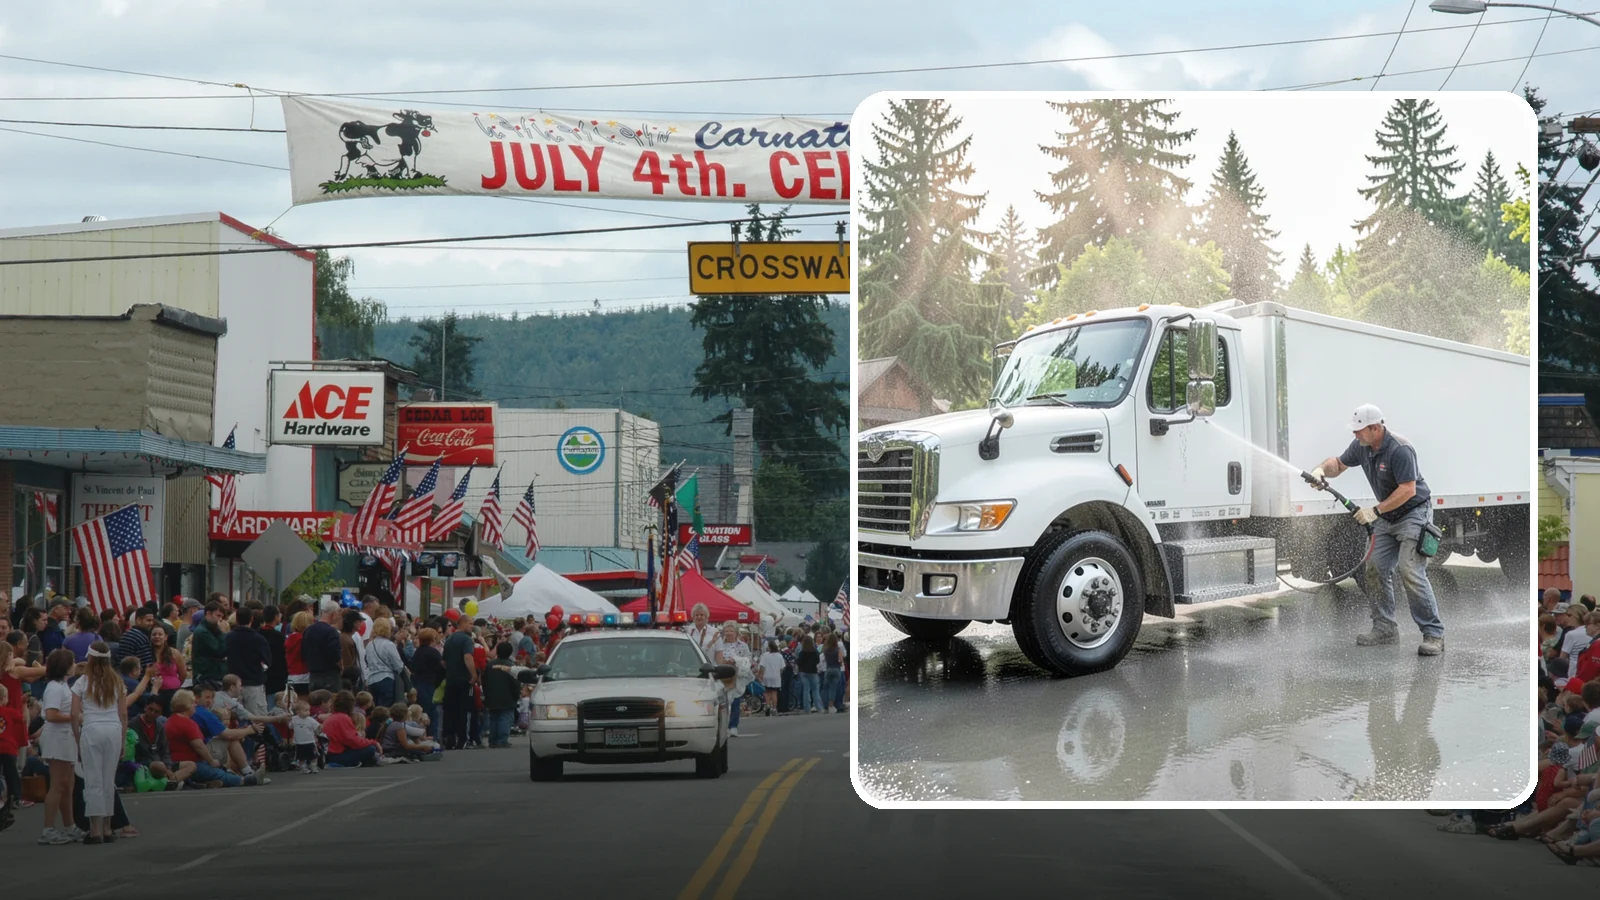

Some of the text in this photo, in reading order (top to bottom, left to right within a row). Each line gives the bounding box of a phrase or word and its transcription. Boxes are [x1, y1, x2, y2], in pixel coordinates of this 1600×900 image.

[481, 141, 605, 192] JULY
[633, 150, 746, 198] 4th.
[697, 254, 850, 280] CROSSWA
[283, 380, 373, 420] ACE
[406, 408, 485, 422] CEDAR LOG
[283, 421, 371, 436] Hardware
[96, 486, 124, 494] Vincent
[138, 487, 155, 495] Paul
[688, 526, 741, 535] CRNATION
[699, 535, 730, 543] GLASS
